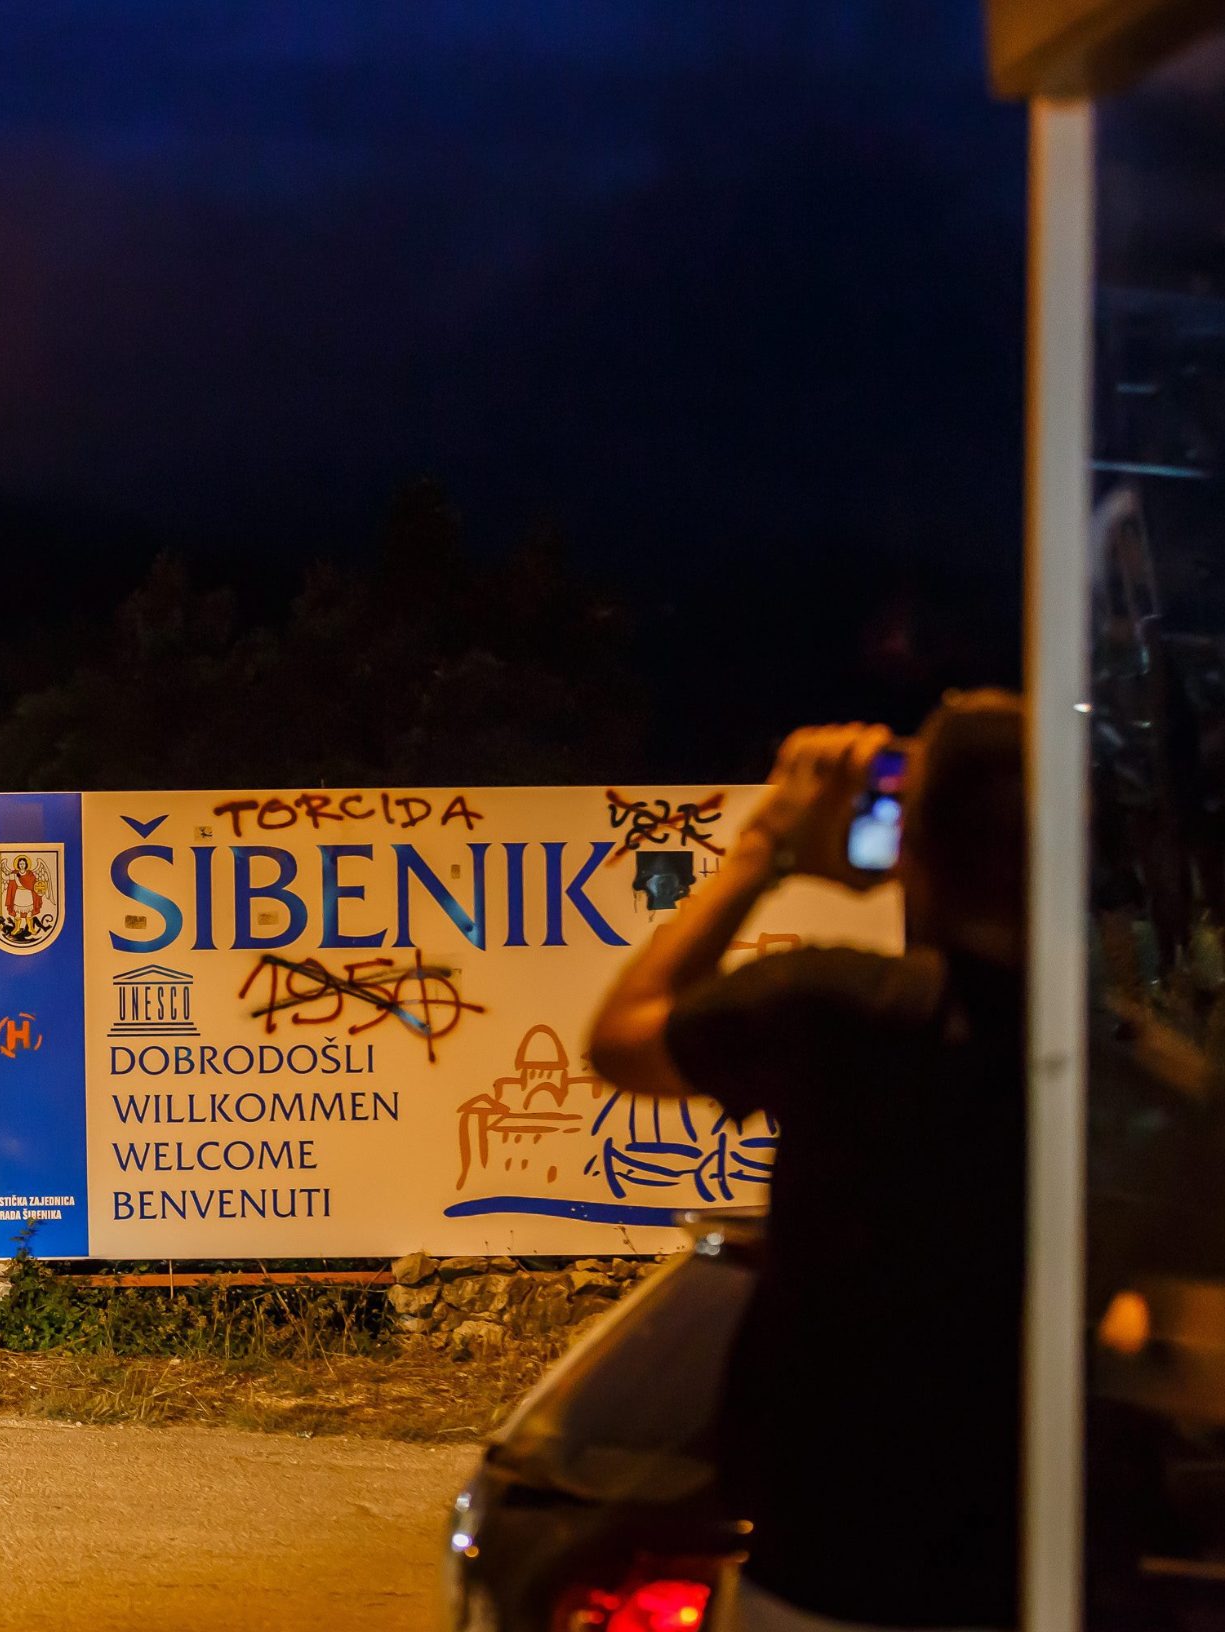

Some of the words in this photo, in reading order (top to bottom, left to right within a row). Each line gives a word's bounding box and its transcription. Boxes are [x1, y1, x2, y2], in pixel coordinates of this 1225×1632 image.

[214, 793, 483, 838] TORCIDA
[108, 814, 632, 952] ŠIBENIK
[118, 985, 191, 1021] UNESCO
[109, 1036, 375, 1076] DOBRODOŠLI
[111, 1091, 400, 1124] WILLKOMMEN
[111, 1140, 318, 1172] WELCOME
[22, 1208, 63, 1220] ŠIBENIKA
[28, 1196, 75, 1206] ZAJEDNICA
[113, 1188, 331, 1221] BENVENUTI
